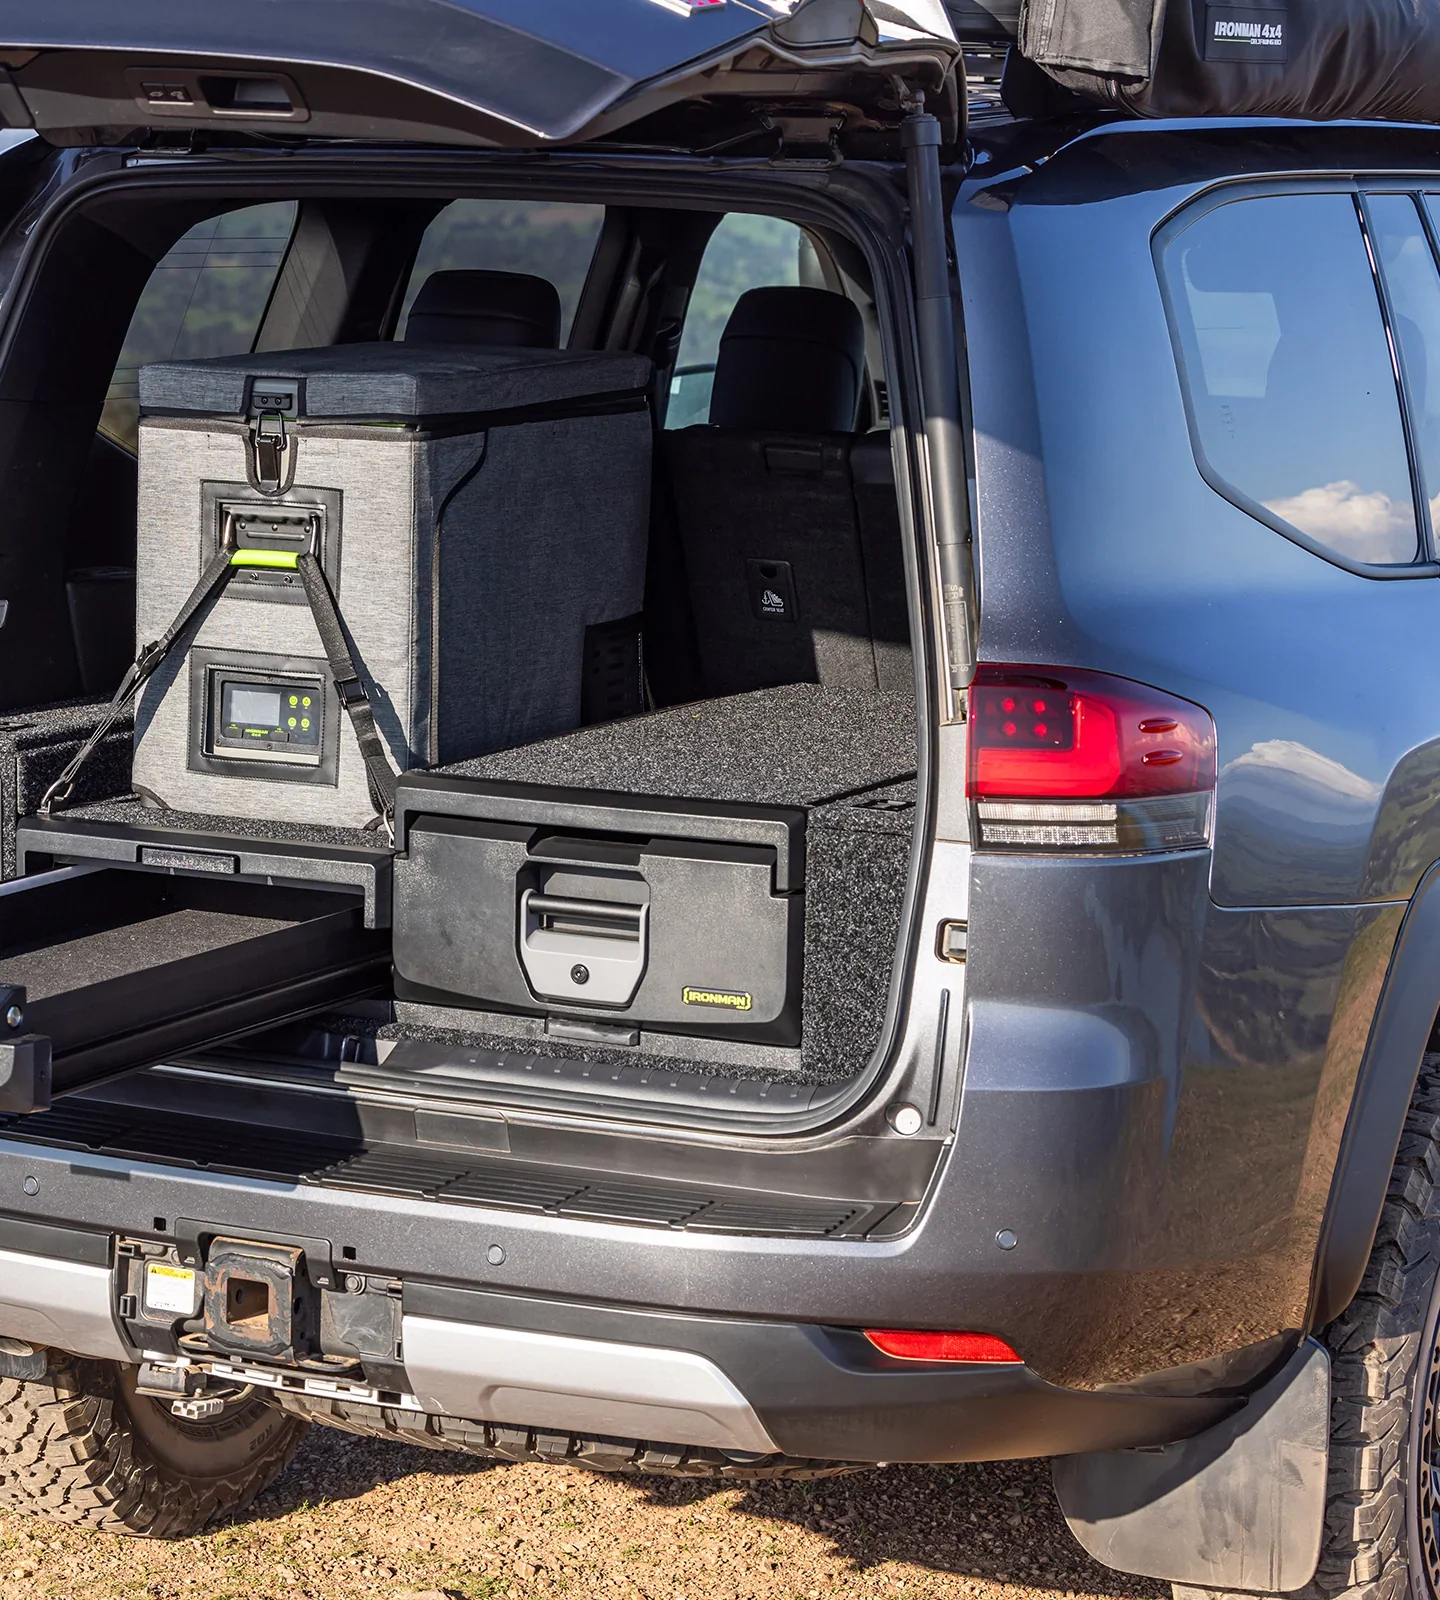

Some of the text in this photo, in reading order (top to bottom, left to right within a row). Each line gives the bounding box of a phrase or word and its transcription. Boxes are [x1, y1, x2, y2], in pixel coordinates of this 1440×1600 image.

[1214, 21, 1282, 38] IRONMAN 4x4
[950, 584, 959, 599] SR
[688, 991, 746, 1006] IRONMAN
